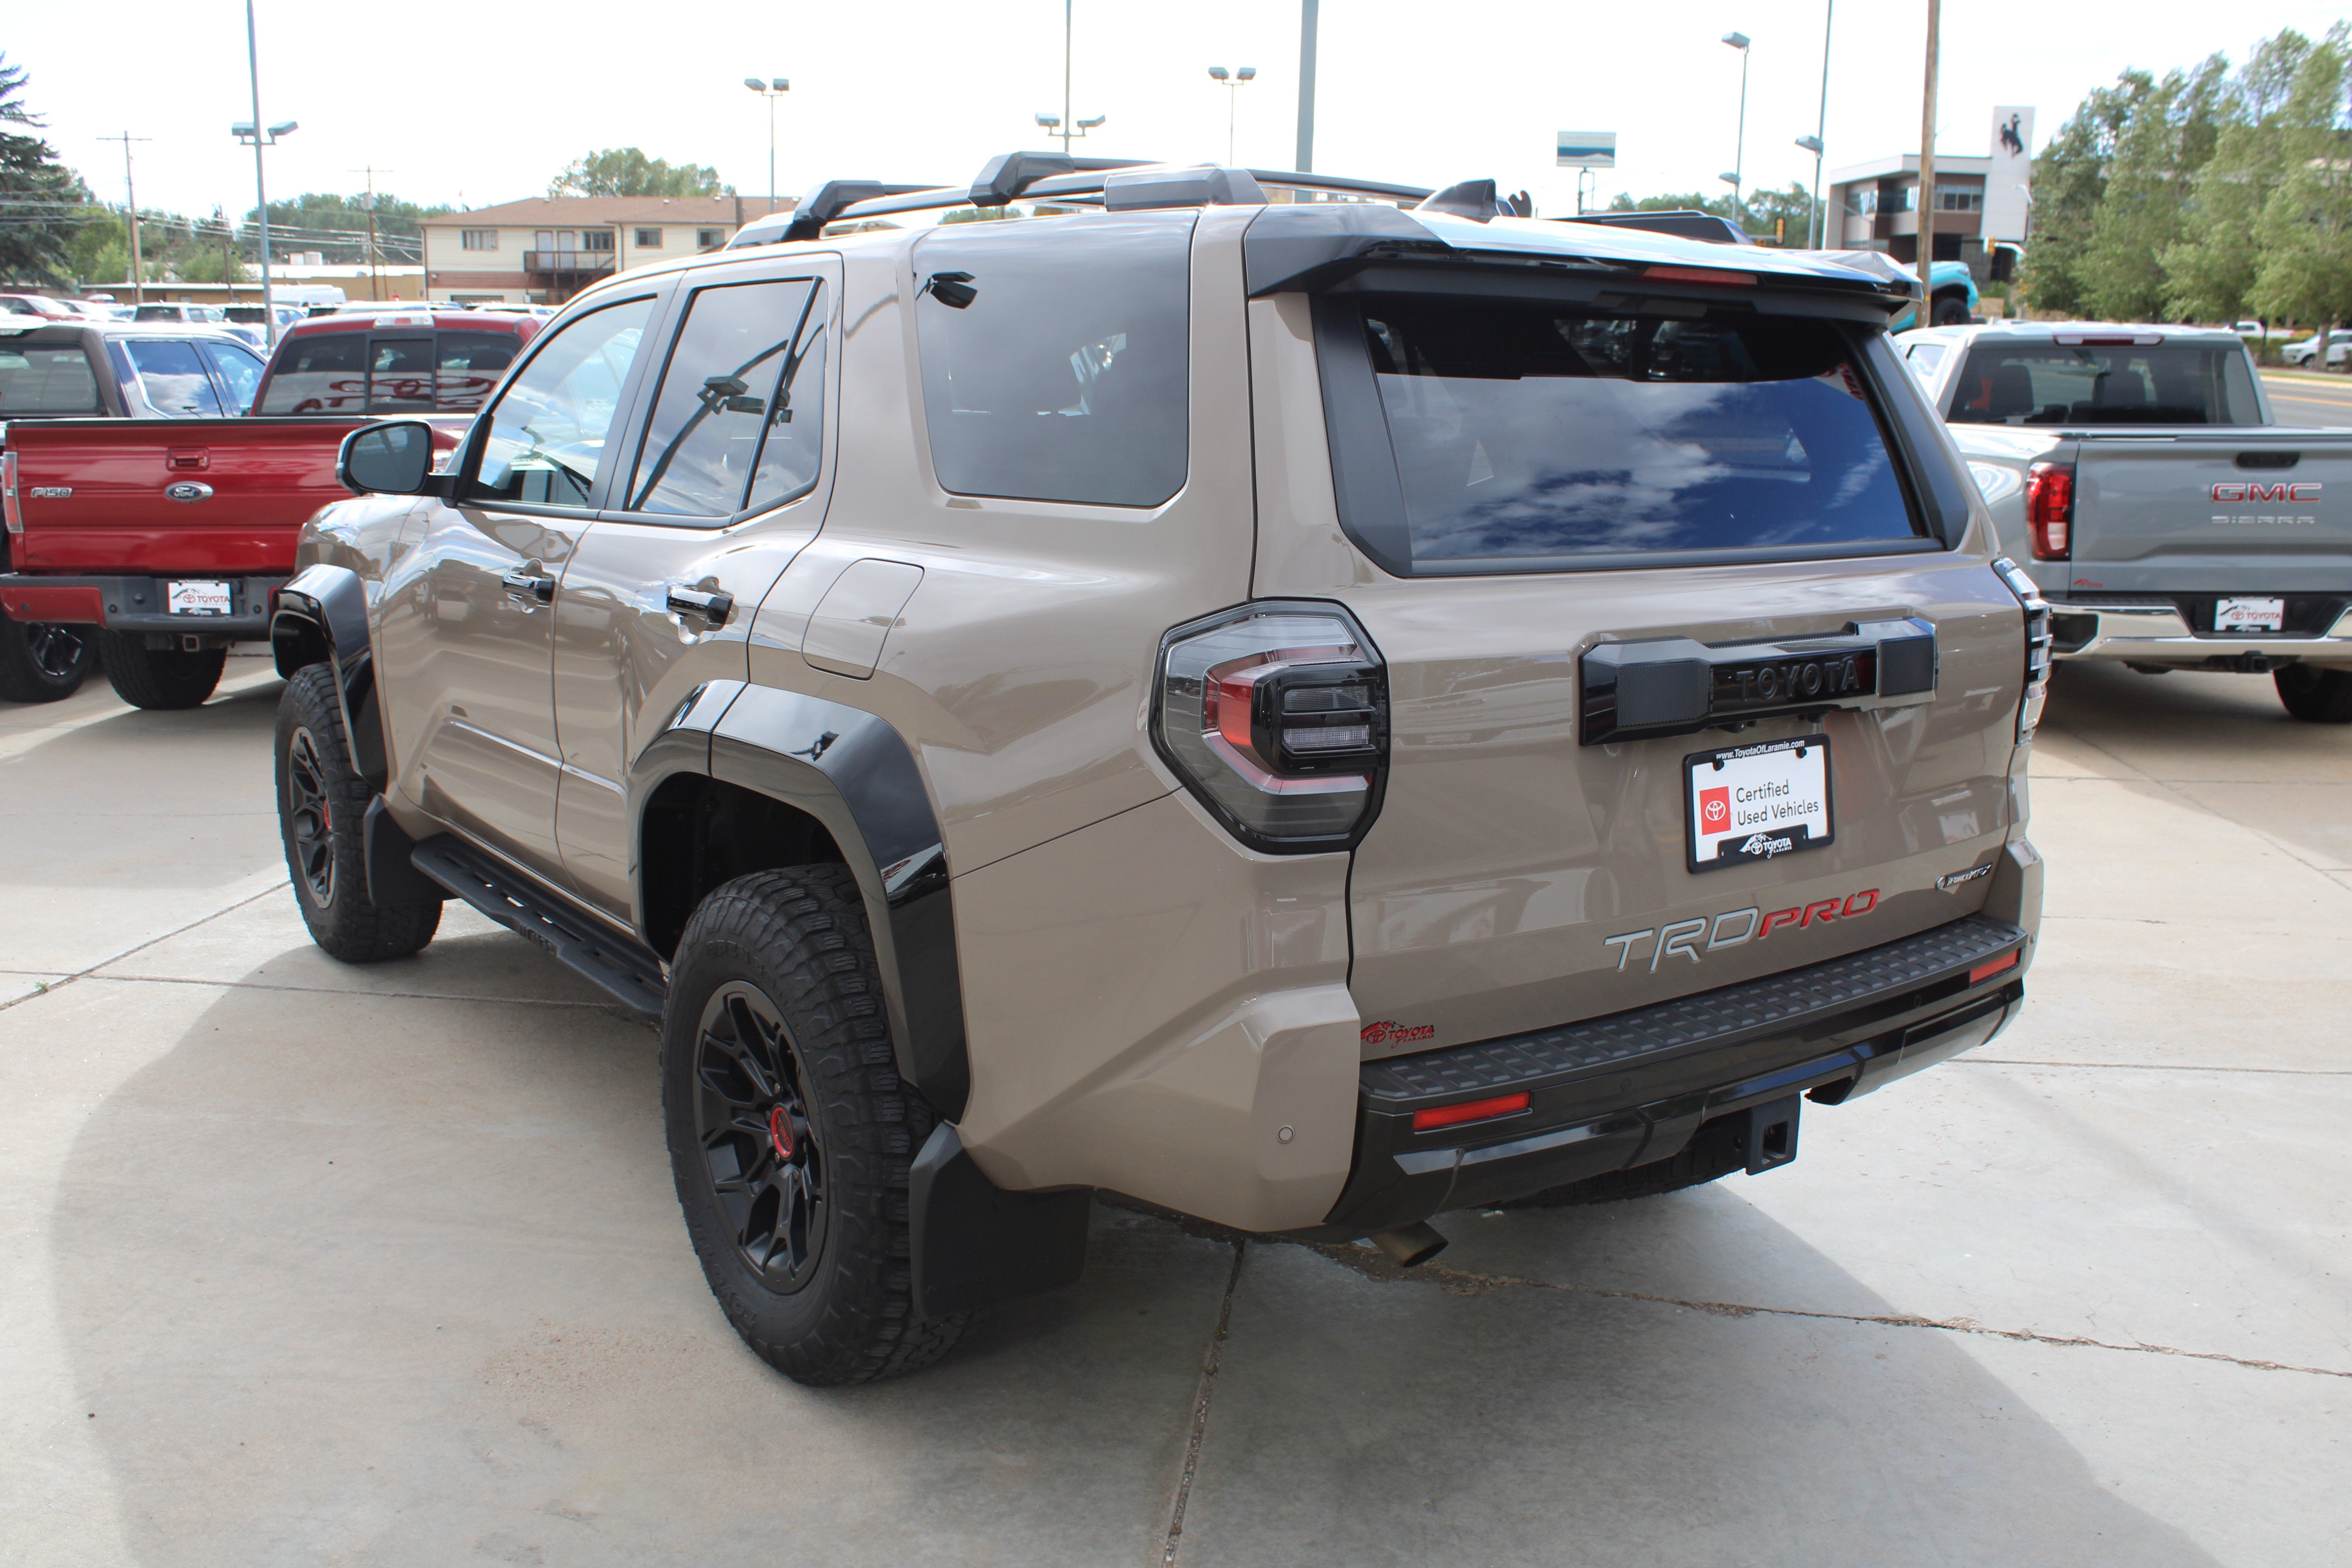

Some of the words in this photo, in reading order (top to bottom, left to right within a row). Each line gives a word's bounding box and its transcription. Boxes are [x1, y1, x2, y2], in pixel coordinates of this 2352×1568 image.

[174, 486, 195, 497] Ford
[2211, 482, 2322, 503] GMC
[2211, 515, 2316, 524] SIERRA
[1736, 658, 1860, 702] TOYOTA
[1716, 740, 1804, 759] www.ToyotaOfLaramie.com
[1736, 779, 1789, 803] Certified
[1737, 805, 1768, 826] Used
[1771, 799, 1819, 819] Vehicles
[1763, 837, 1792, 851] TOYOTA
[1604, 907, 1759, 973] TRD
[1758, 889, 1880, 938] PRO
[1388, 1024, 1435, 1041] TOYOTA
